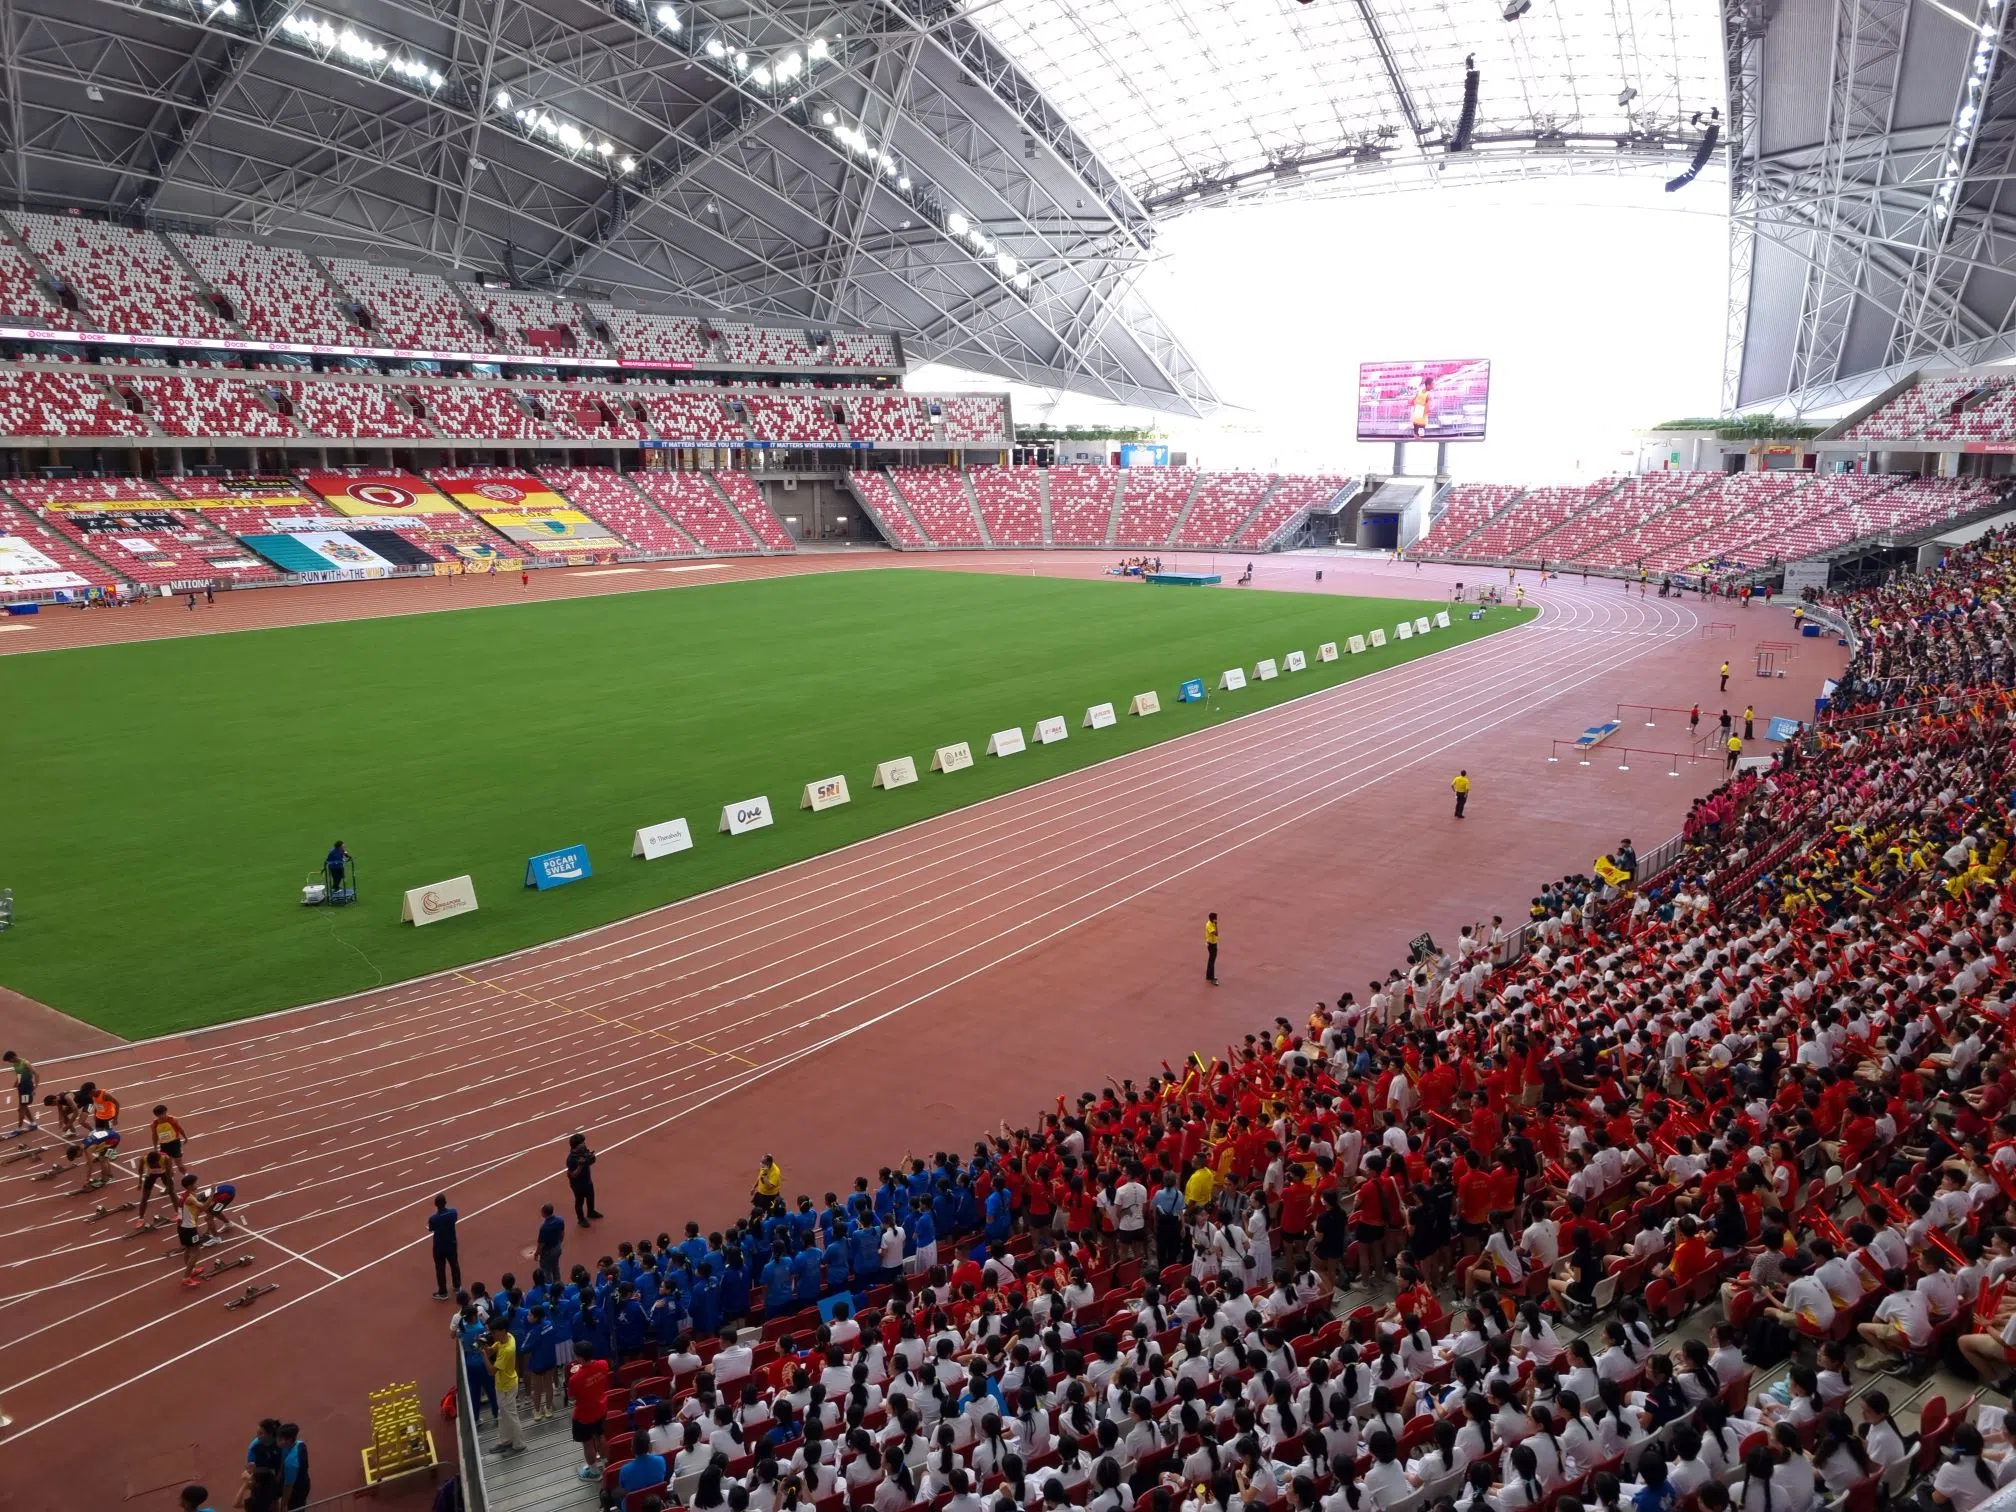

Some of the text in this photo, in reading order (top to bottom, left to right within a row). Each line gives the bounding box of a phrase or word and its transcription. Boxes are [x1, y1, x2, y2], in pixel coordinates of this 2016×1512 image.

[301, 567, 385, 582] RUN WITH THE WIND
[738, 807, 761, 823] One
[657, 831, 681, 841] Therabody
[544, 854, 577, 869] POCARI
[545, 862, 575, 875] SWEAT
